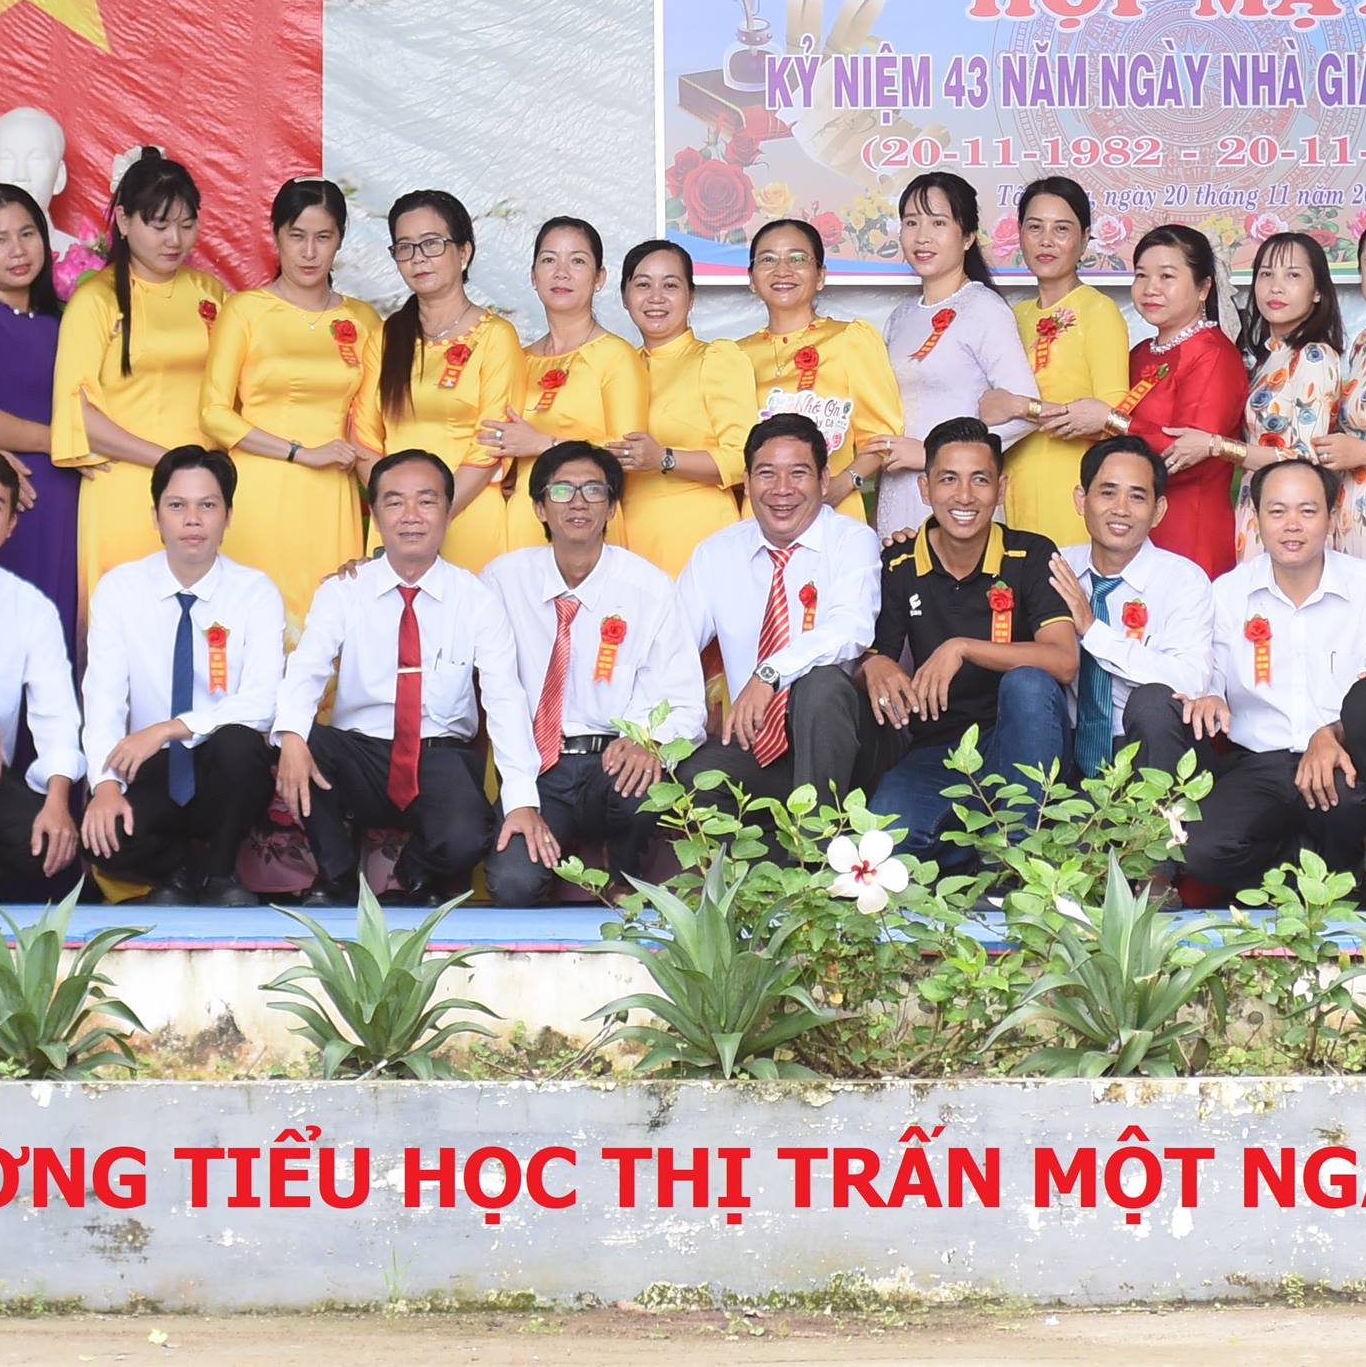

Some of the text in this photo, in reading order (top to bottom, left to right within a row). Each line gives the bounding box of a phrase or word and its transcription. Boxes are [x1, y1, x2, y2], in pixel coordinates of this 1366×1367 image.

[766, 35, 822, 109] KỶ
[834, 43, 932, 126] NIỆM
[943, 55, 989, 108] 43
[1002, 41, 1088, 108] NĂM
[1101, 39, 1211, 108] NGÀY
[1223, 39, 1306, 107] NHÀ
[861, 136, 1164, 171] (20-11-1982
[1104, 185, 1158, 210] ngày
[1163, 184, 1187, 207] 20
[1195, 183, 1259, 210] tháng
[1267, 184, 1290, 206] 11
[1296, 185, 1345, 206] năm
